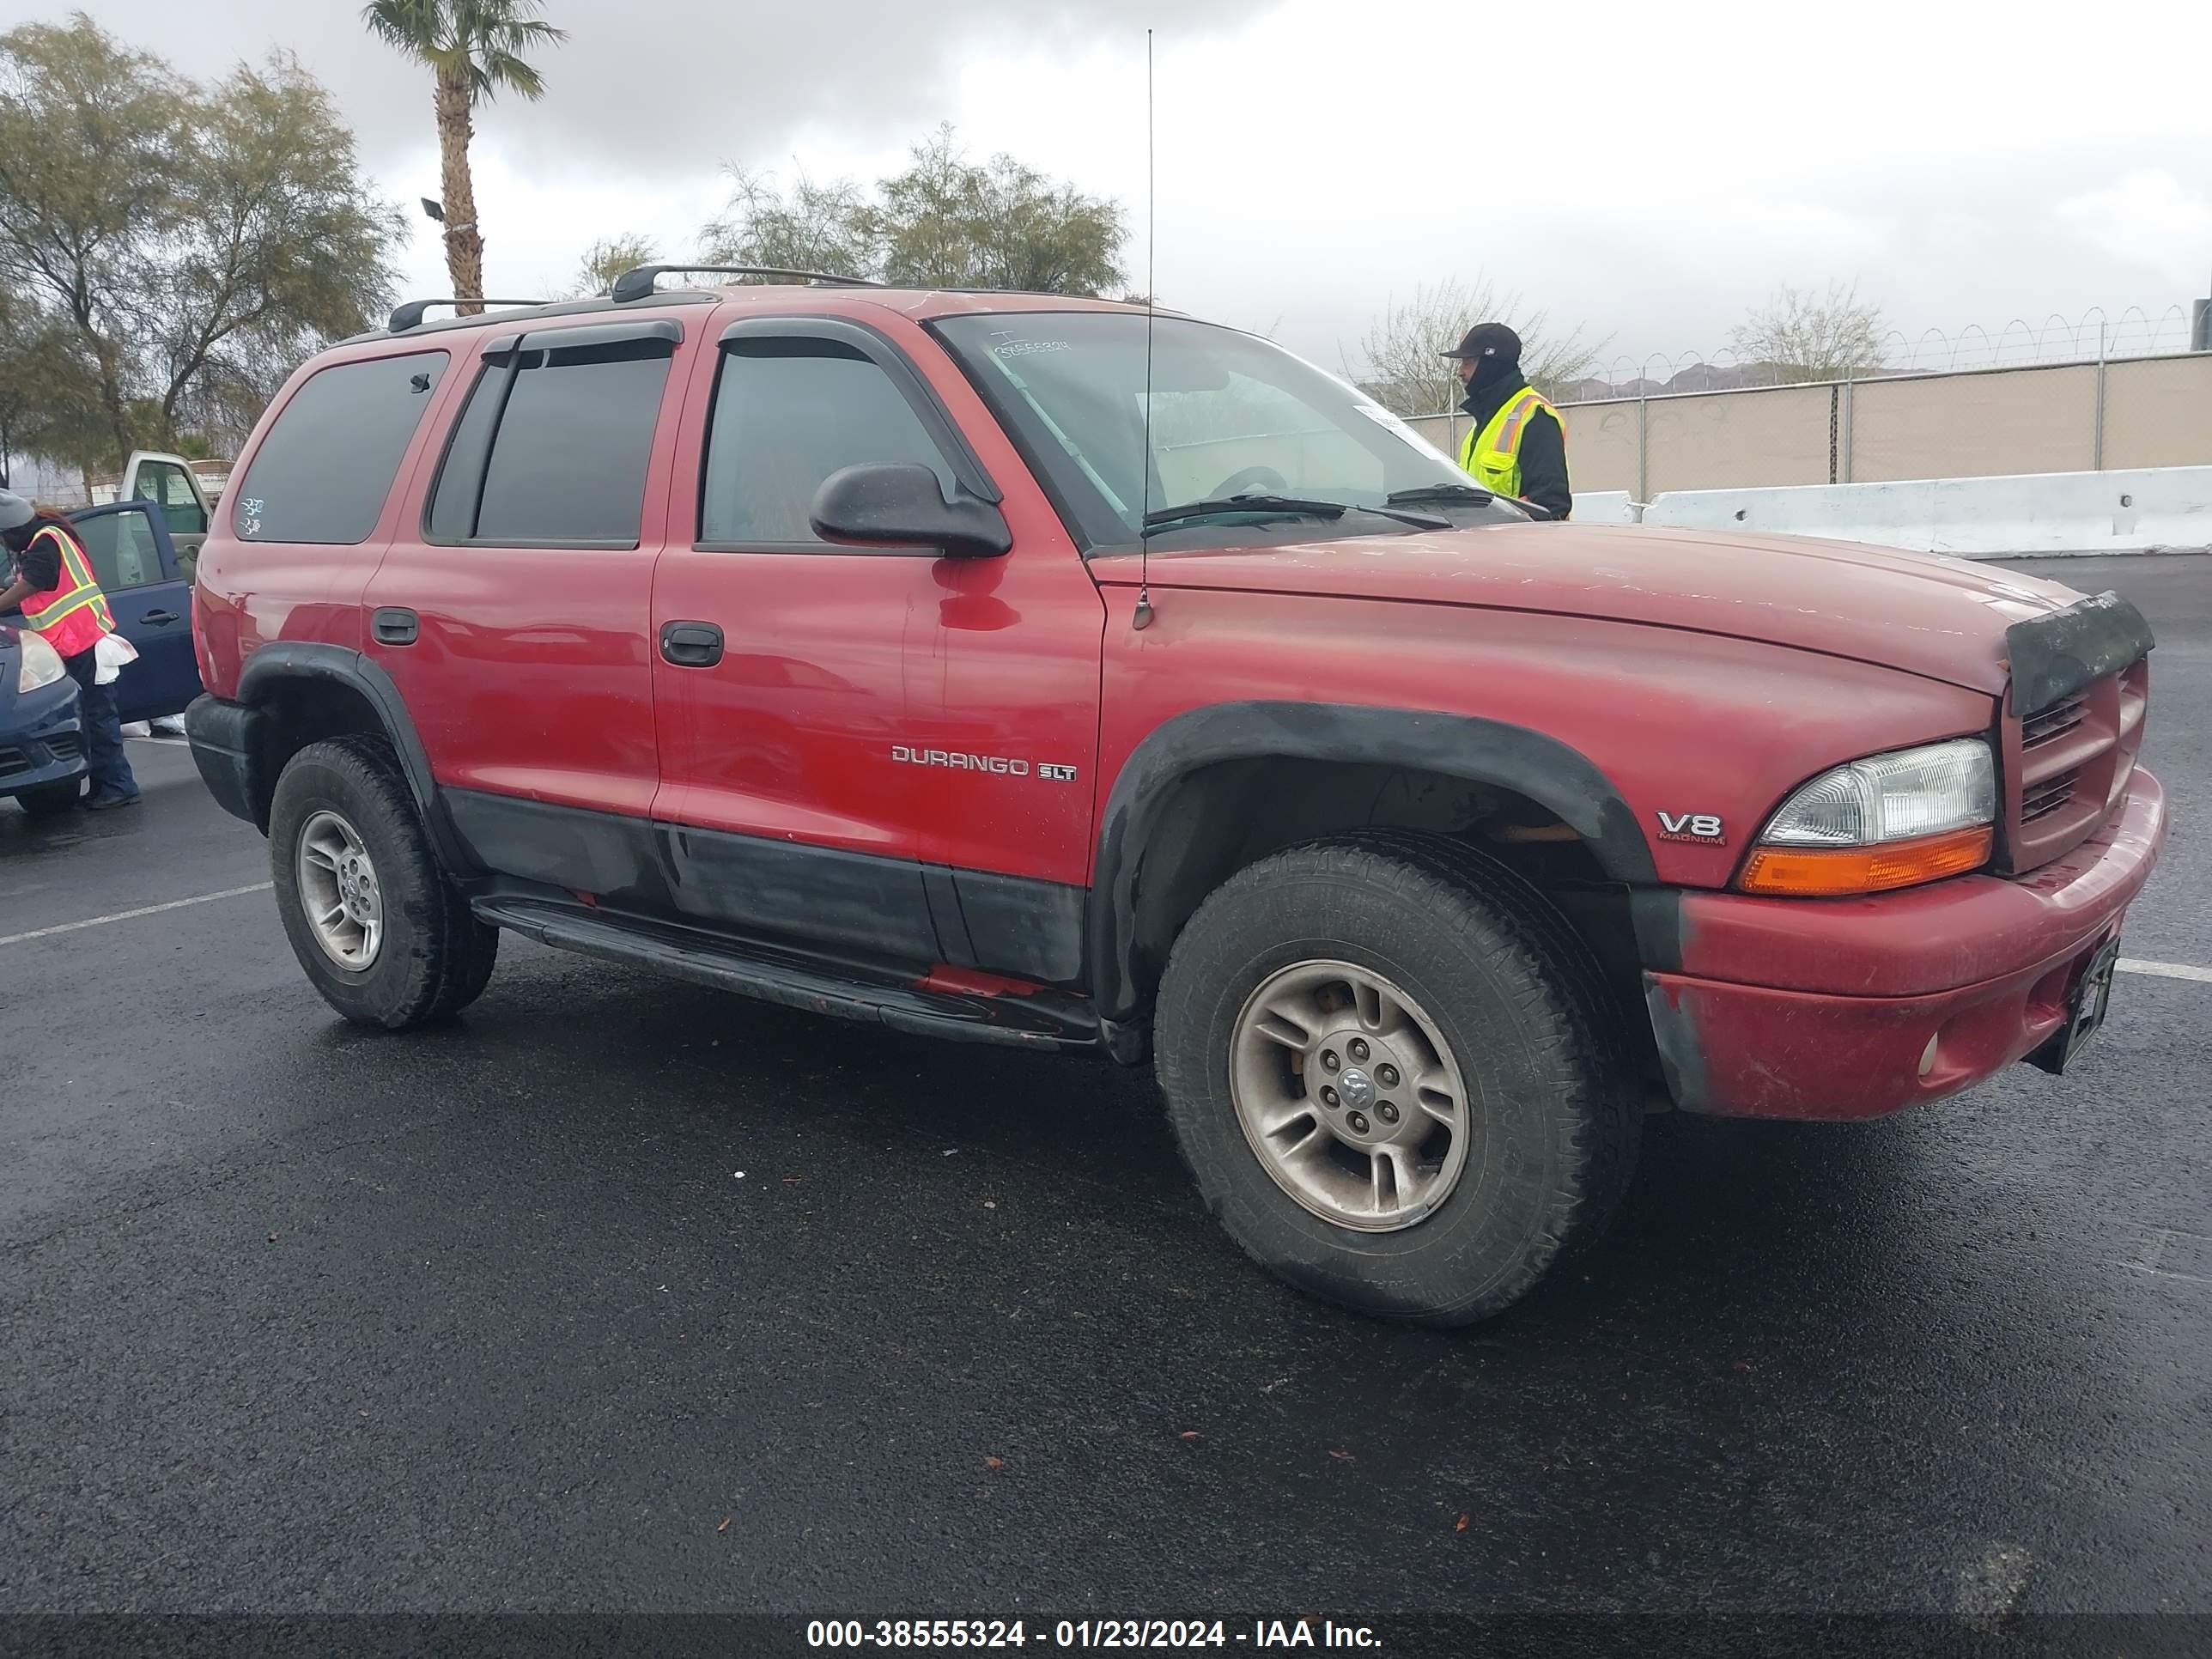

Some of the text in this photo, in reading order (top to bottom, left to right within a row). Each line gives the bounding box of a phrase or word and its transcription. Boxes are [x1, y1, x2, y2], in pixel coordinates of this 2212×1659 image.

[994, 341, 1072, 359] 38555324
[892, 745, 1075, 781] DURANGO SLT
[1656, 811, 1721, 836] V8
[1658, 831, 1724, 846] MAGNUM
